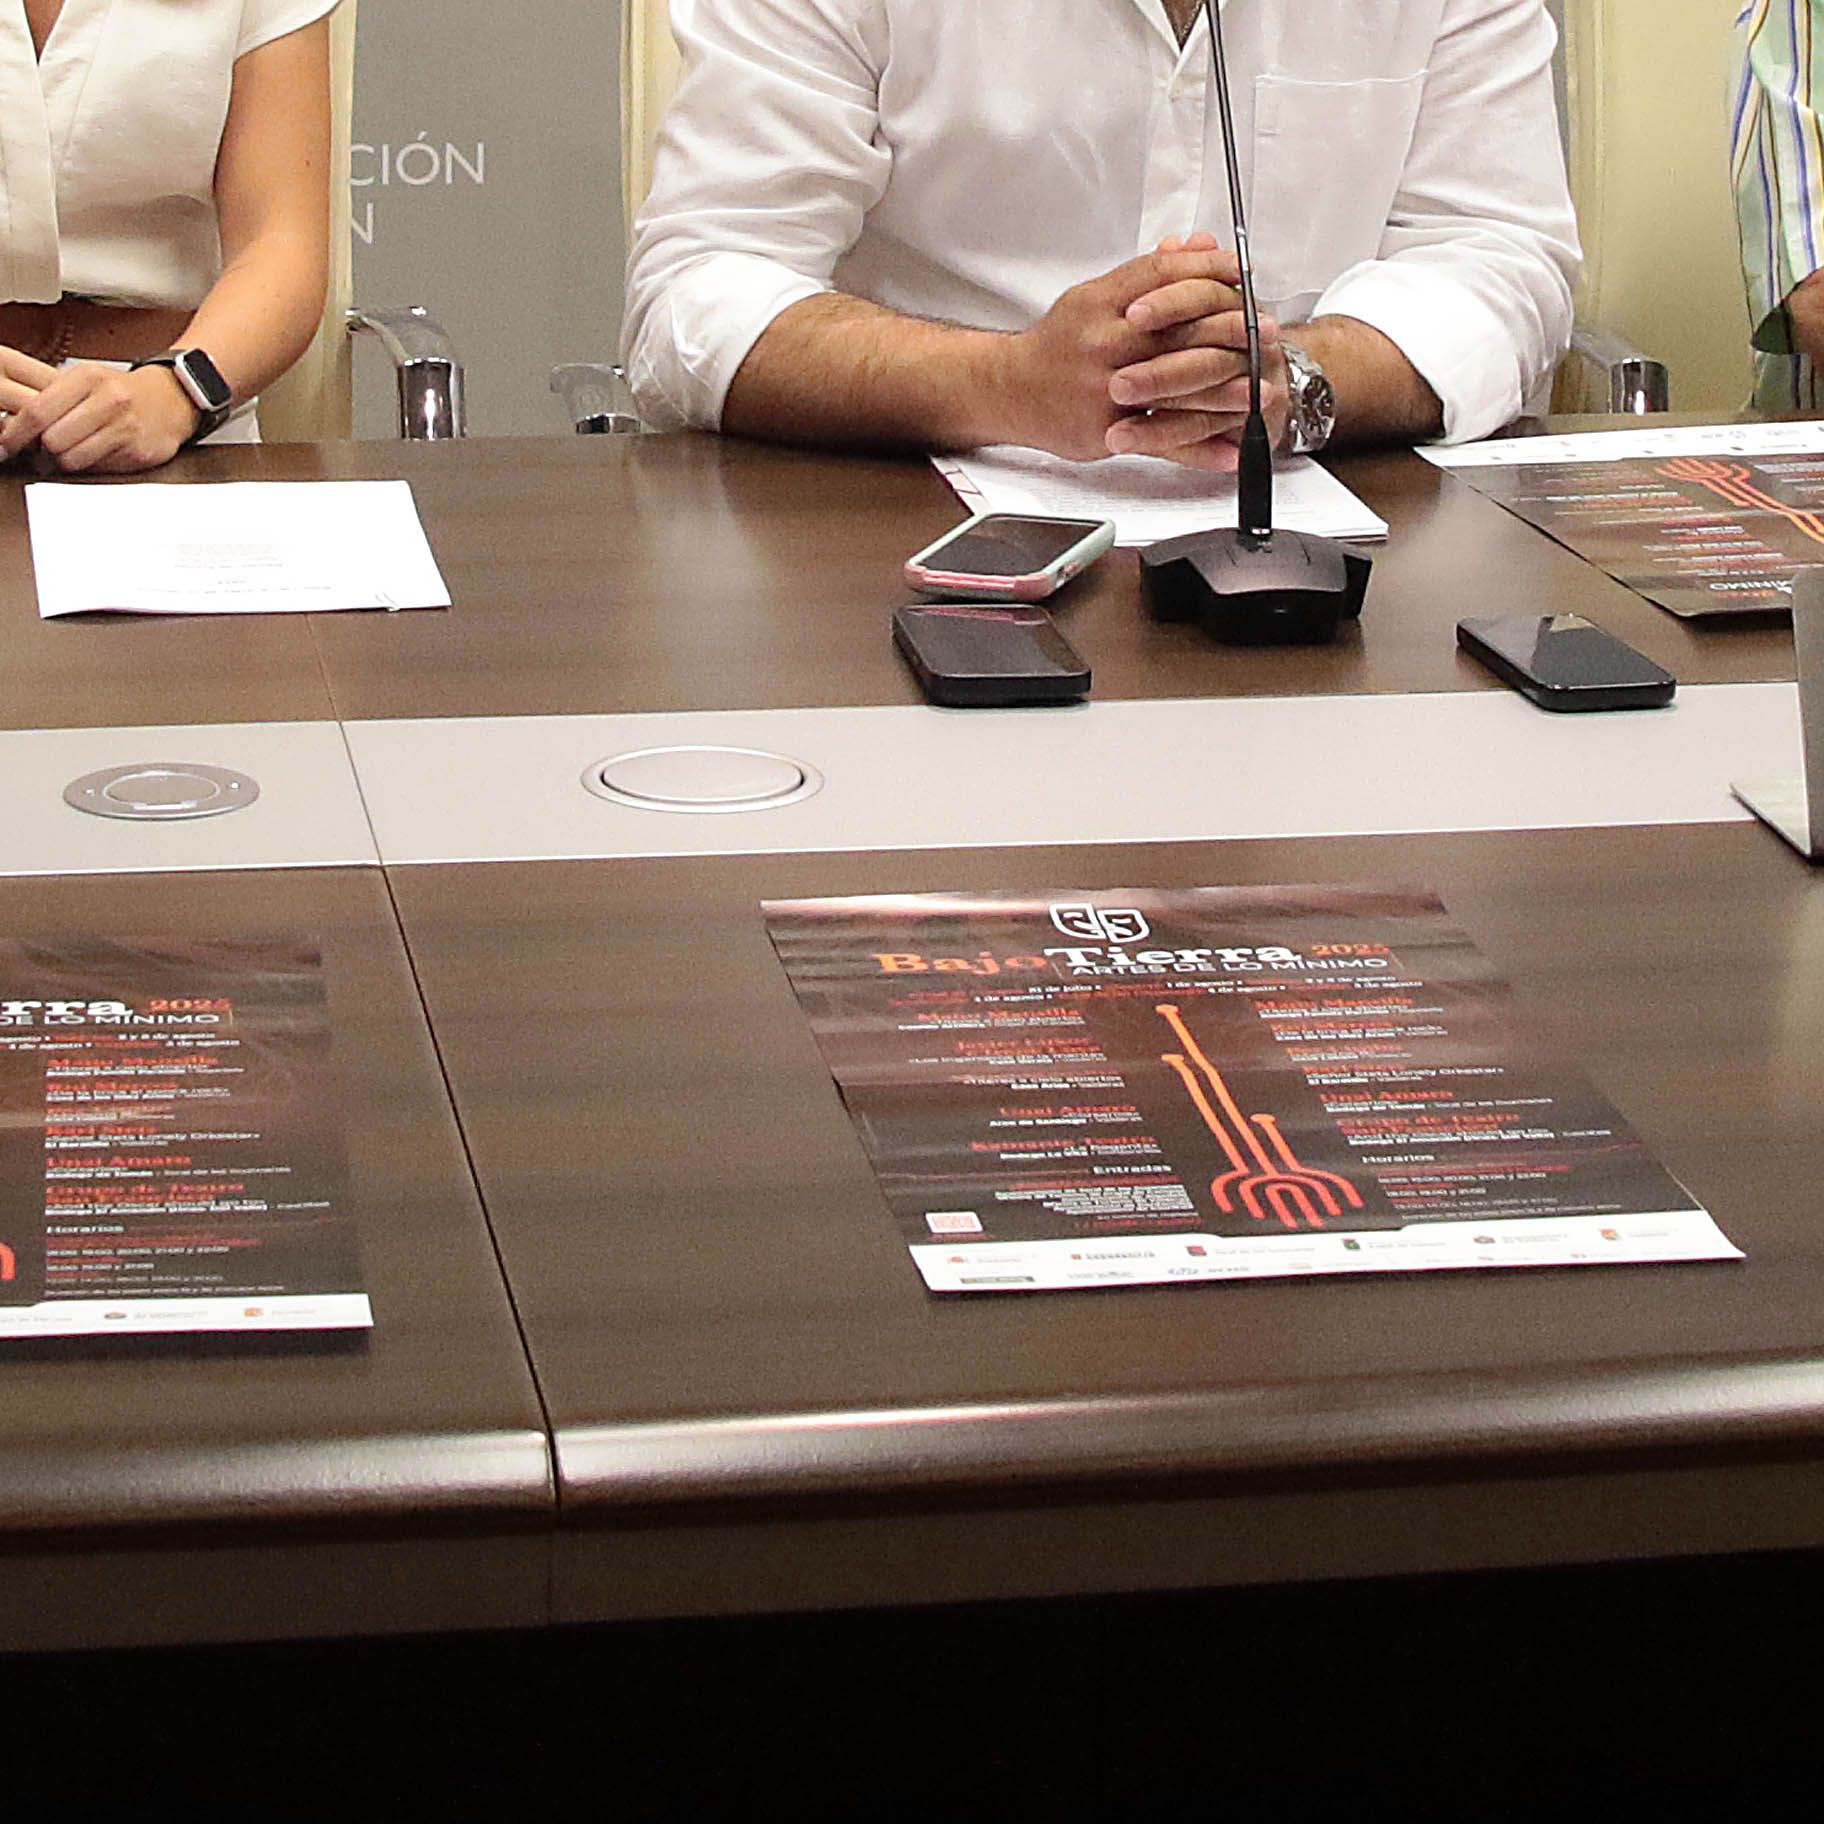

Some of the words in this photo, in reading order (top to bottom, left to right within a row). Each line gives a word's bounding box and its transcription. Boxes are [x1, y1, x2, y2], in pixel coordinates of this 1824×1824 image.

[871, 950, 1048, 975] Bajo
[1043, 944, 1302, 968] Tierra
[1072, 963, 1167, 976] ARTES
[1172, 962, 1216, 974] DE
[1224, 960, 1263, 972] LO
[44, 1014, 85, 1026] LO
